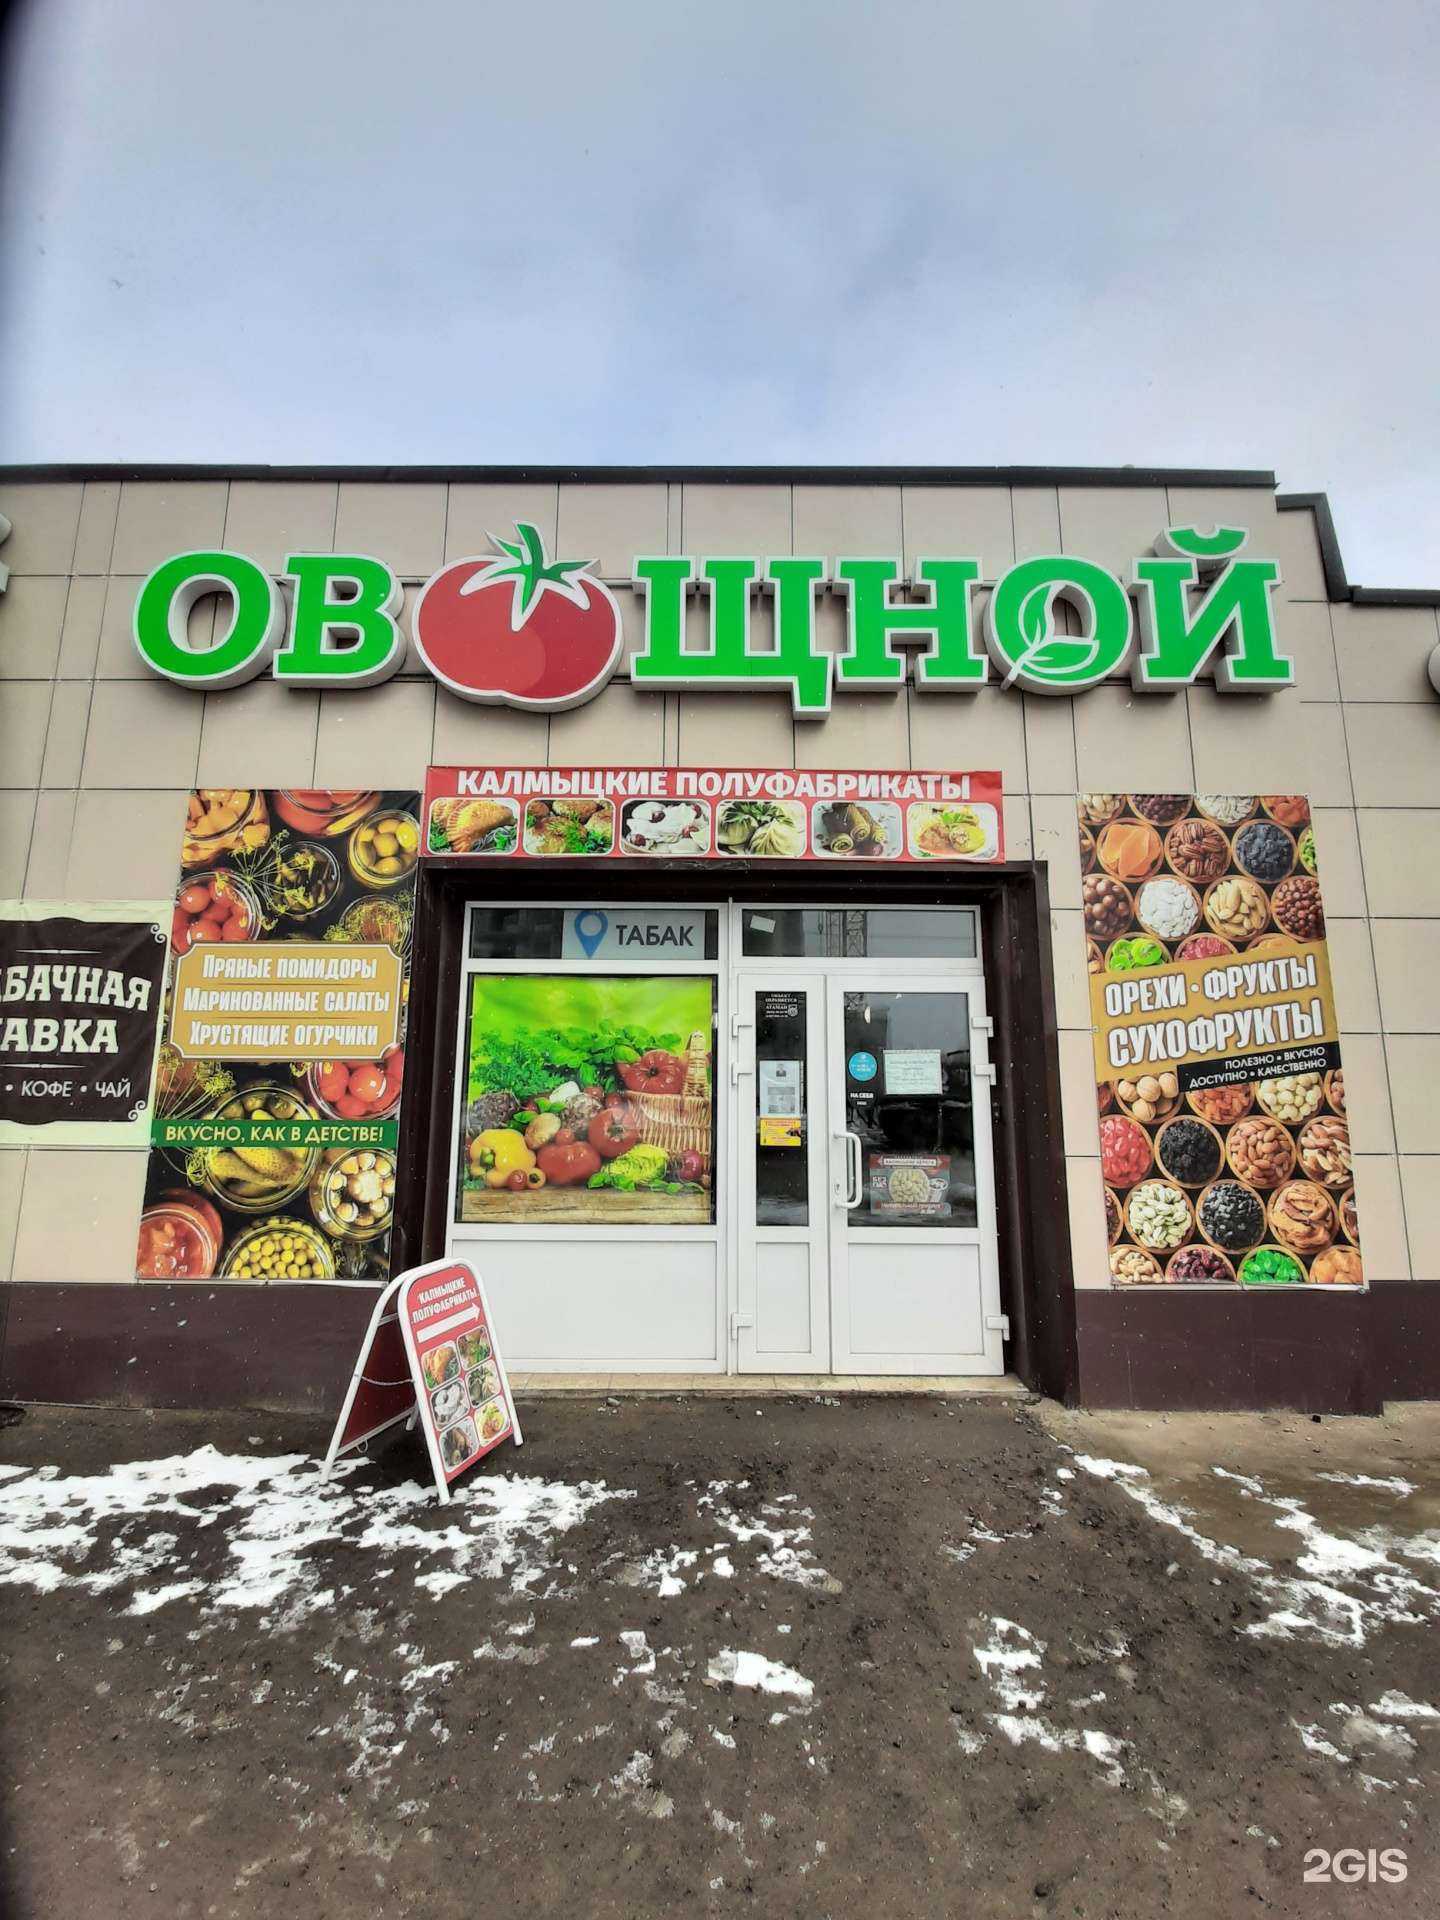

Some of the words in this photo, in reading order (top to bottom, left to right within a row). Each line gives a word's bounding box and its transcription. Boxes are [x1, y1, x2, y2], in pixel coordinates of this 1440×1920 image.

[456, 769, 668, 799] КАЛМЫЦКИЕ
[676, 771, 971, 799] ПОЛУФАБРИКАТЫ
[615, 923, 694, 948] ТАБАК
[0, 965, 152, 1012] БАЧНАЯ
[1105, 974, 1186, 1017] ОРЕХИ
[1203, 954, 1317, 1001] ФРУКТЫ
[0, 1017, 119, 1054] АВКА
[1108, 999, 1324, 1068] СУХОФРУКТЫ
[1225, 1054, 1274, 1070] ПОЛЕЗНО
[1283, 1046, 1325, 1062] ВКУСНО
[21, 1080, 73, 1097] КОФЕ
[95, 1078, 131, 1098] ЧАЙ
[1189, 1070, 1248, 1089] ДОСТУПНО
[1257, 1058, 1326, 1077] КАЧЕСТВЕННО
[166, 1126, 245, 1143] ВКУСНО,
[251, 1126, 286, 1141] КАК
[291, 1126, 301, 1141] В
[305, 1126, 383, 1144] ДЕТСТВЕ!
[412, 1288, 477, 1323] ПОЛУФАБРИКАТЫ
[418, 1277, 466, 1304] КАЛМЫЦКИЕ
